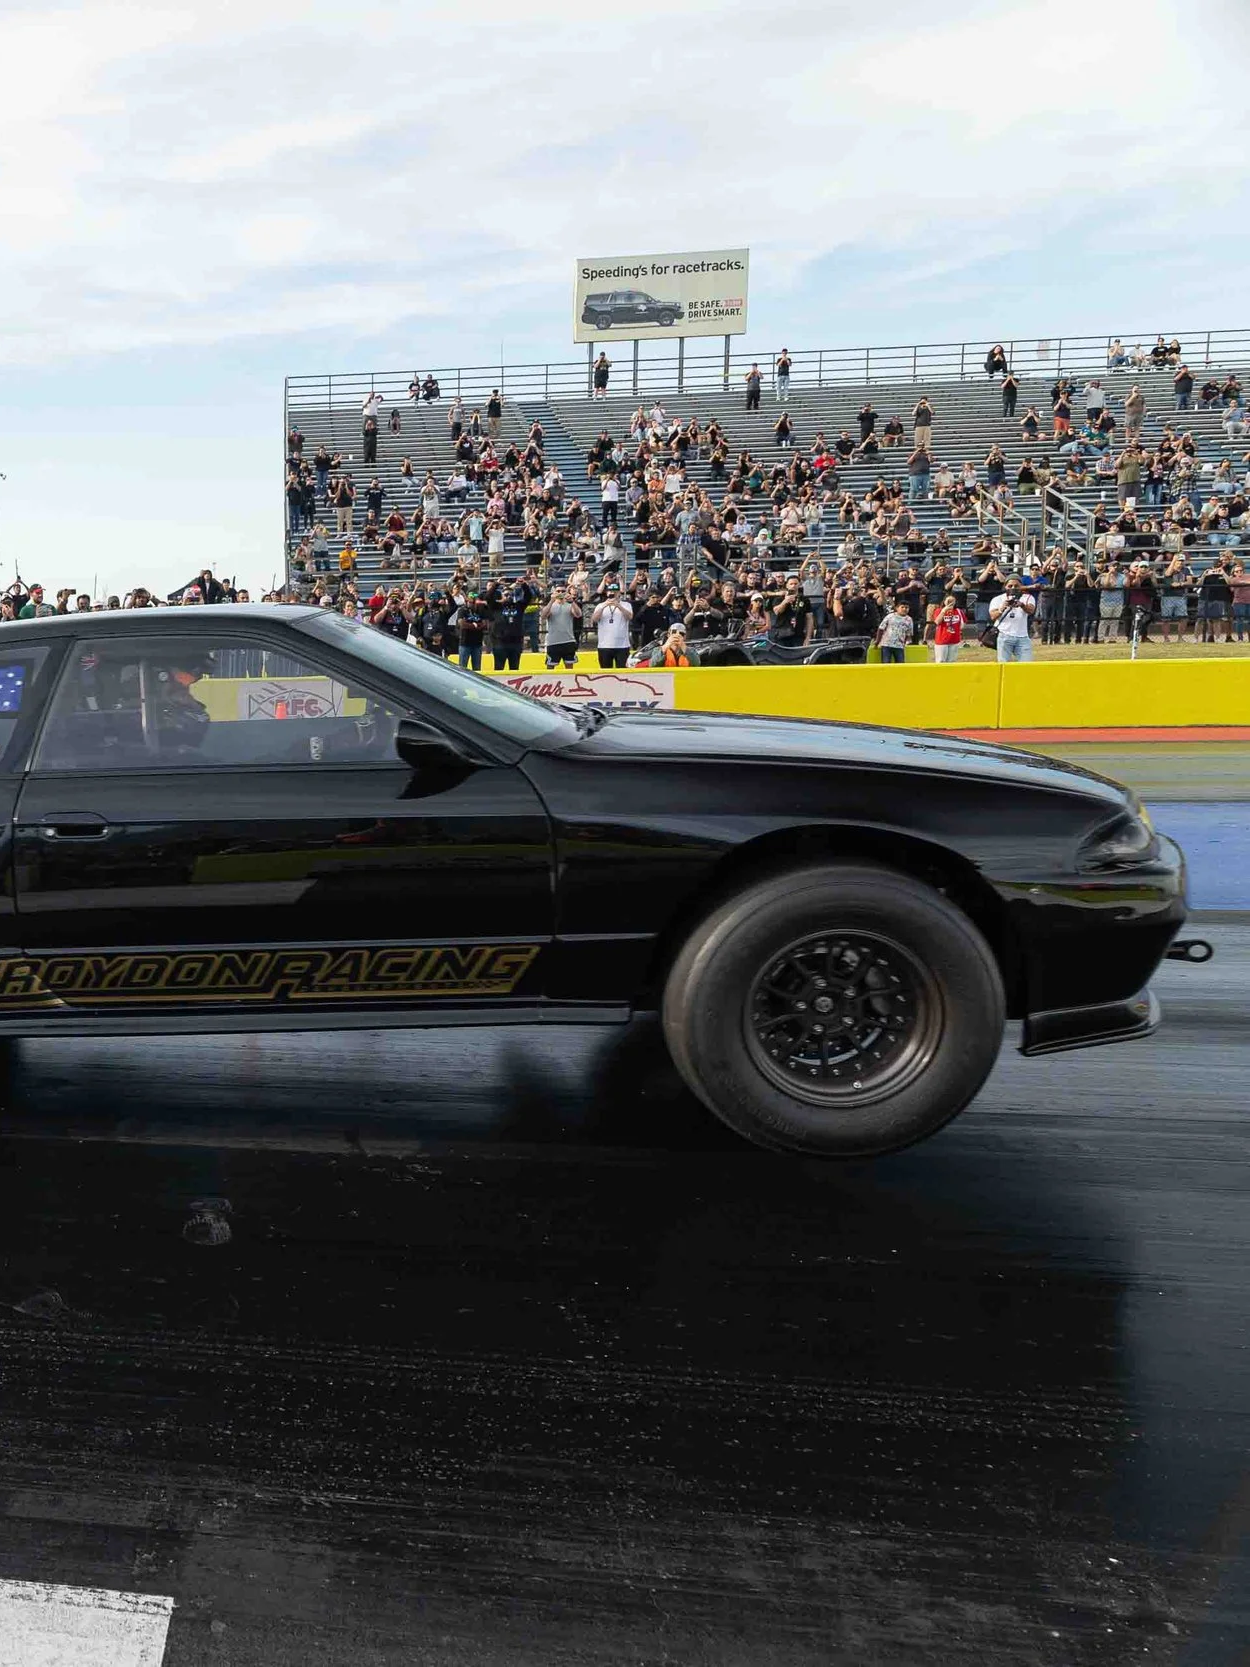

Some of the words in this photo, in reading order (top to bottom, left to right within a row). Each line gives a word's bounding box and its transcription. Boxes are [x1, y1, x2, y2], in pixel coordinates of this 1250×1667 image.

[582, 265, 648, 281] Speeding's
[651, 263, 670, 275] for
[672, 259, 744, 274] racetracks.
[688, 302, 699, 310] BE
[700, 300, 723, 309] SAFE.
[688, 309, 713, 319] DRIVE
[713, 308, 742, 317] SMART.
[272, 946, 541, 999] RACING
